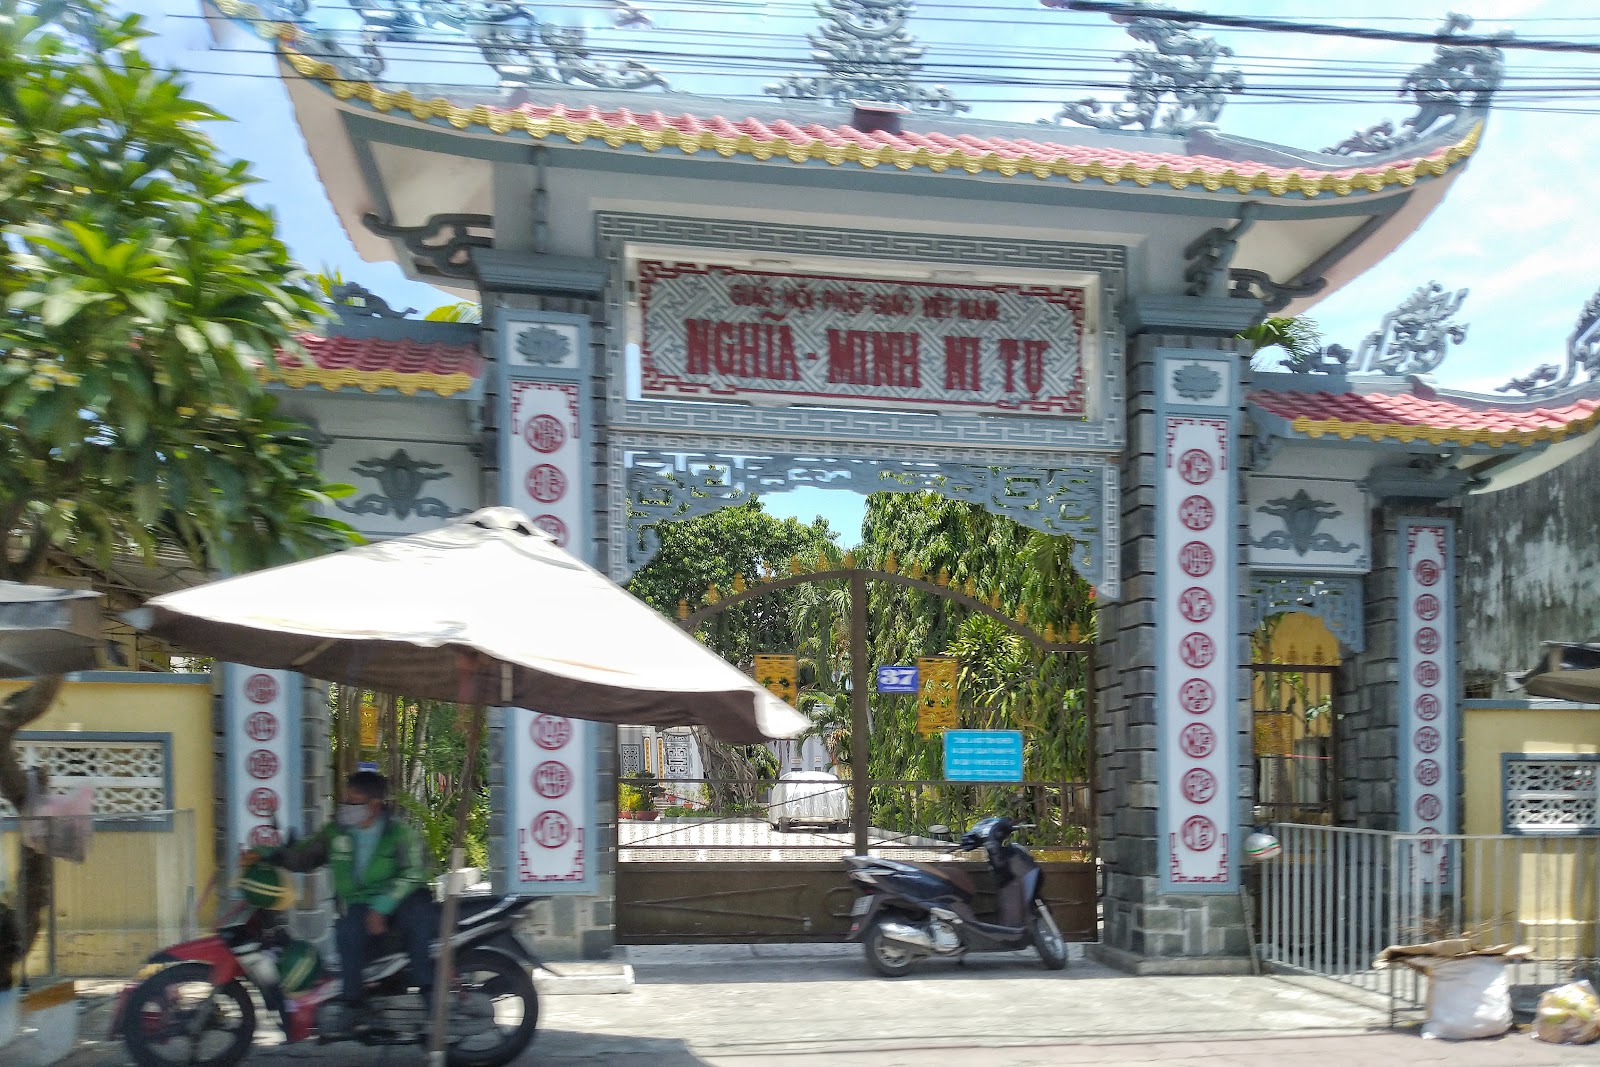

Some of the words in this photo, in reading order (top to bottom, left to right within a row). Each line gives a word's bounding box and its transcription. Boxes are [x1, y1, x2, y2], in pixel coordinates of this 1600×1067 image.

[686, 311, 802, 381] NGHĨA
[826, 329, 922, 388] MINH
[944, 336, 983, 391] NI
[879, 669, 917, 685] 37
